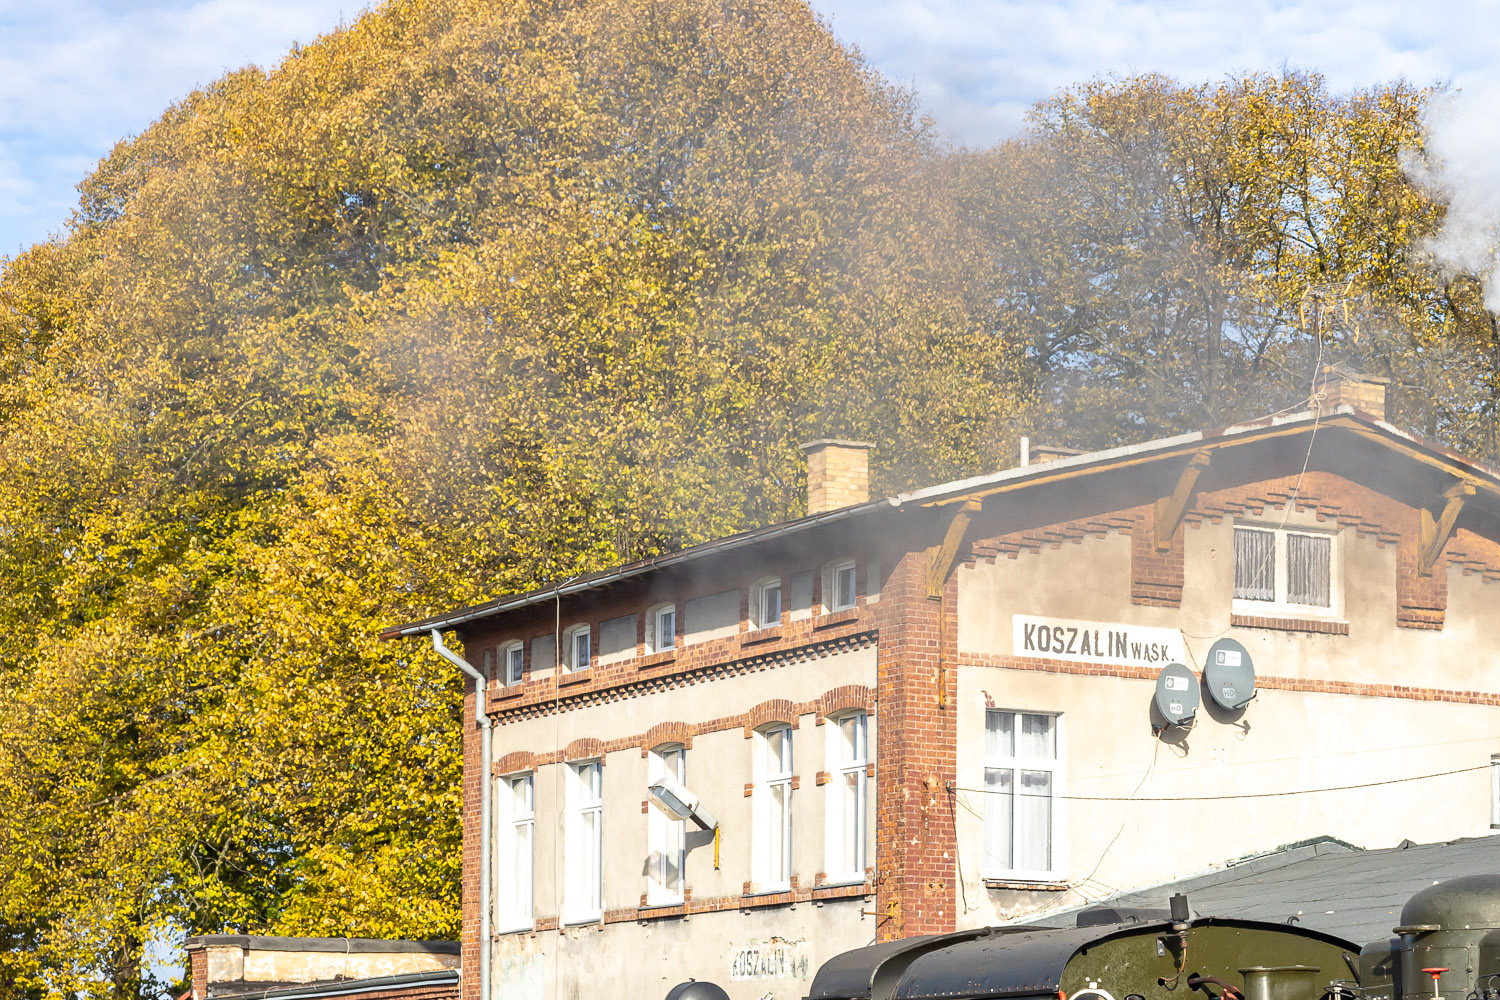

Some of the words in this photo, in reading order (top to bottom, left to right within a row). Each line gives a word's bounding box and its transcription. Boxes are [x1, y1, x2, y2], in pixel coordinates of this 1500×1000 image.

[1023, 623, 1128, 659] KOSZALIN
[1131, 641, 1175, 663] WĄSK.
[1223, 688, 1235, 698] HD
[1171, 704, 1182, 712] HD
